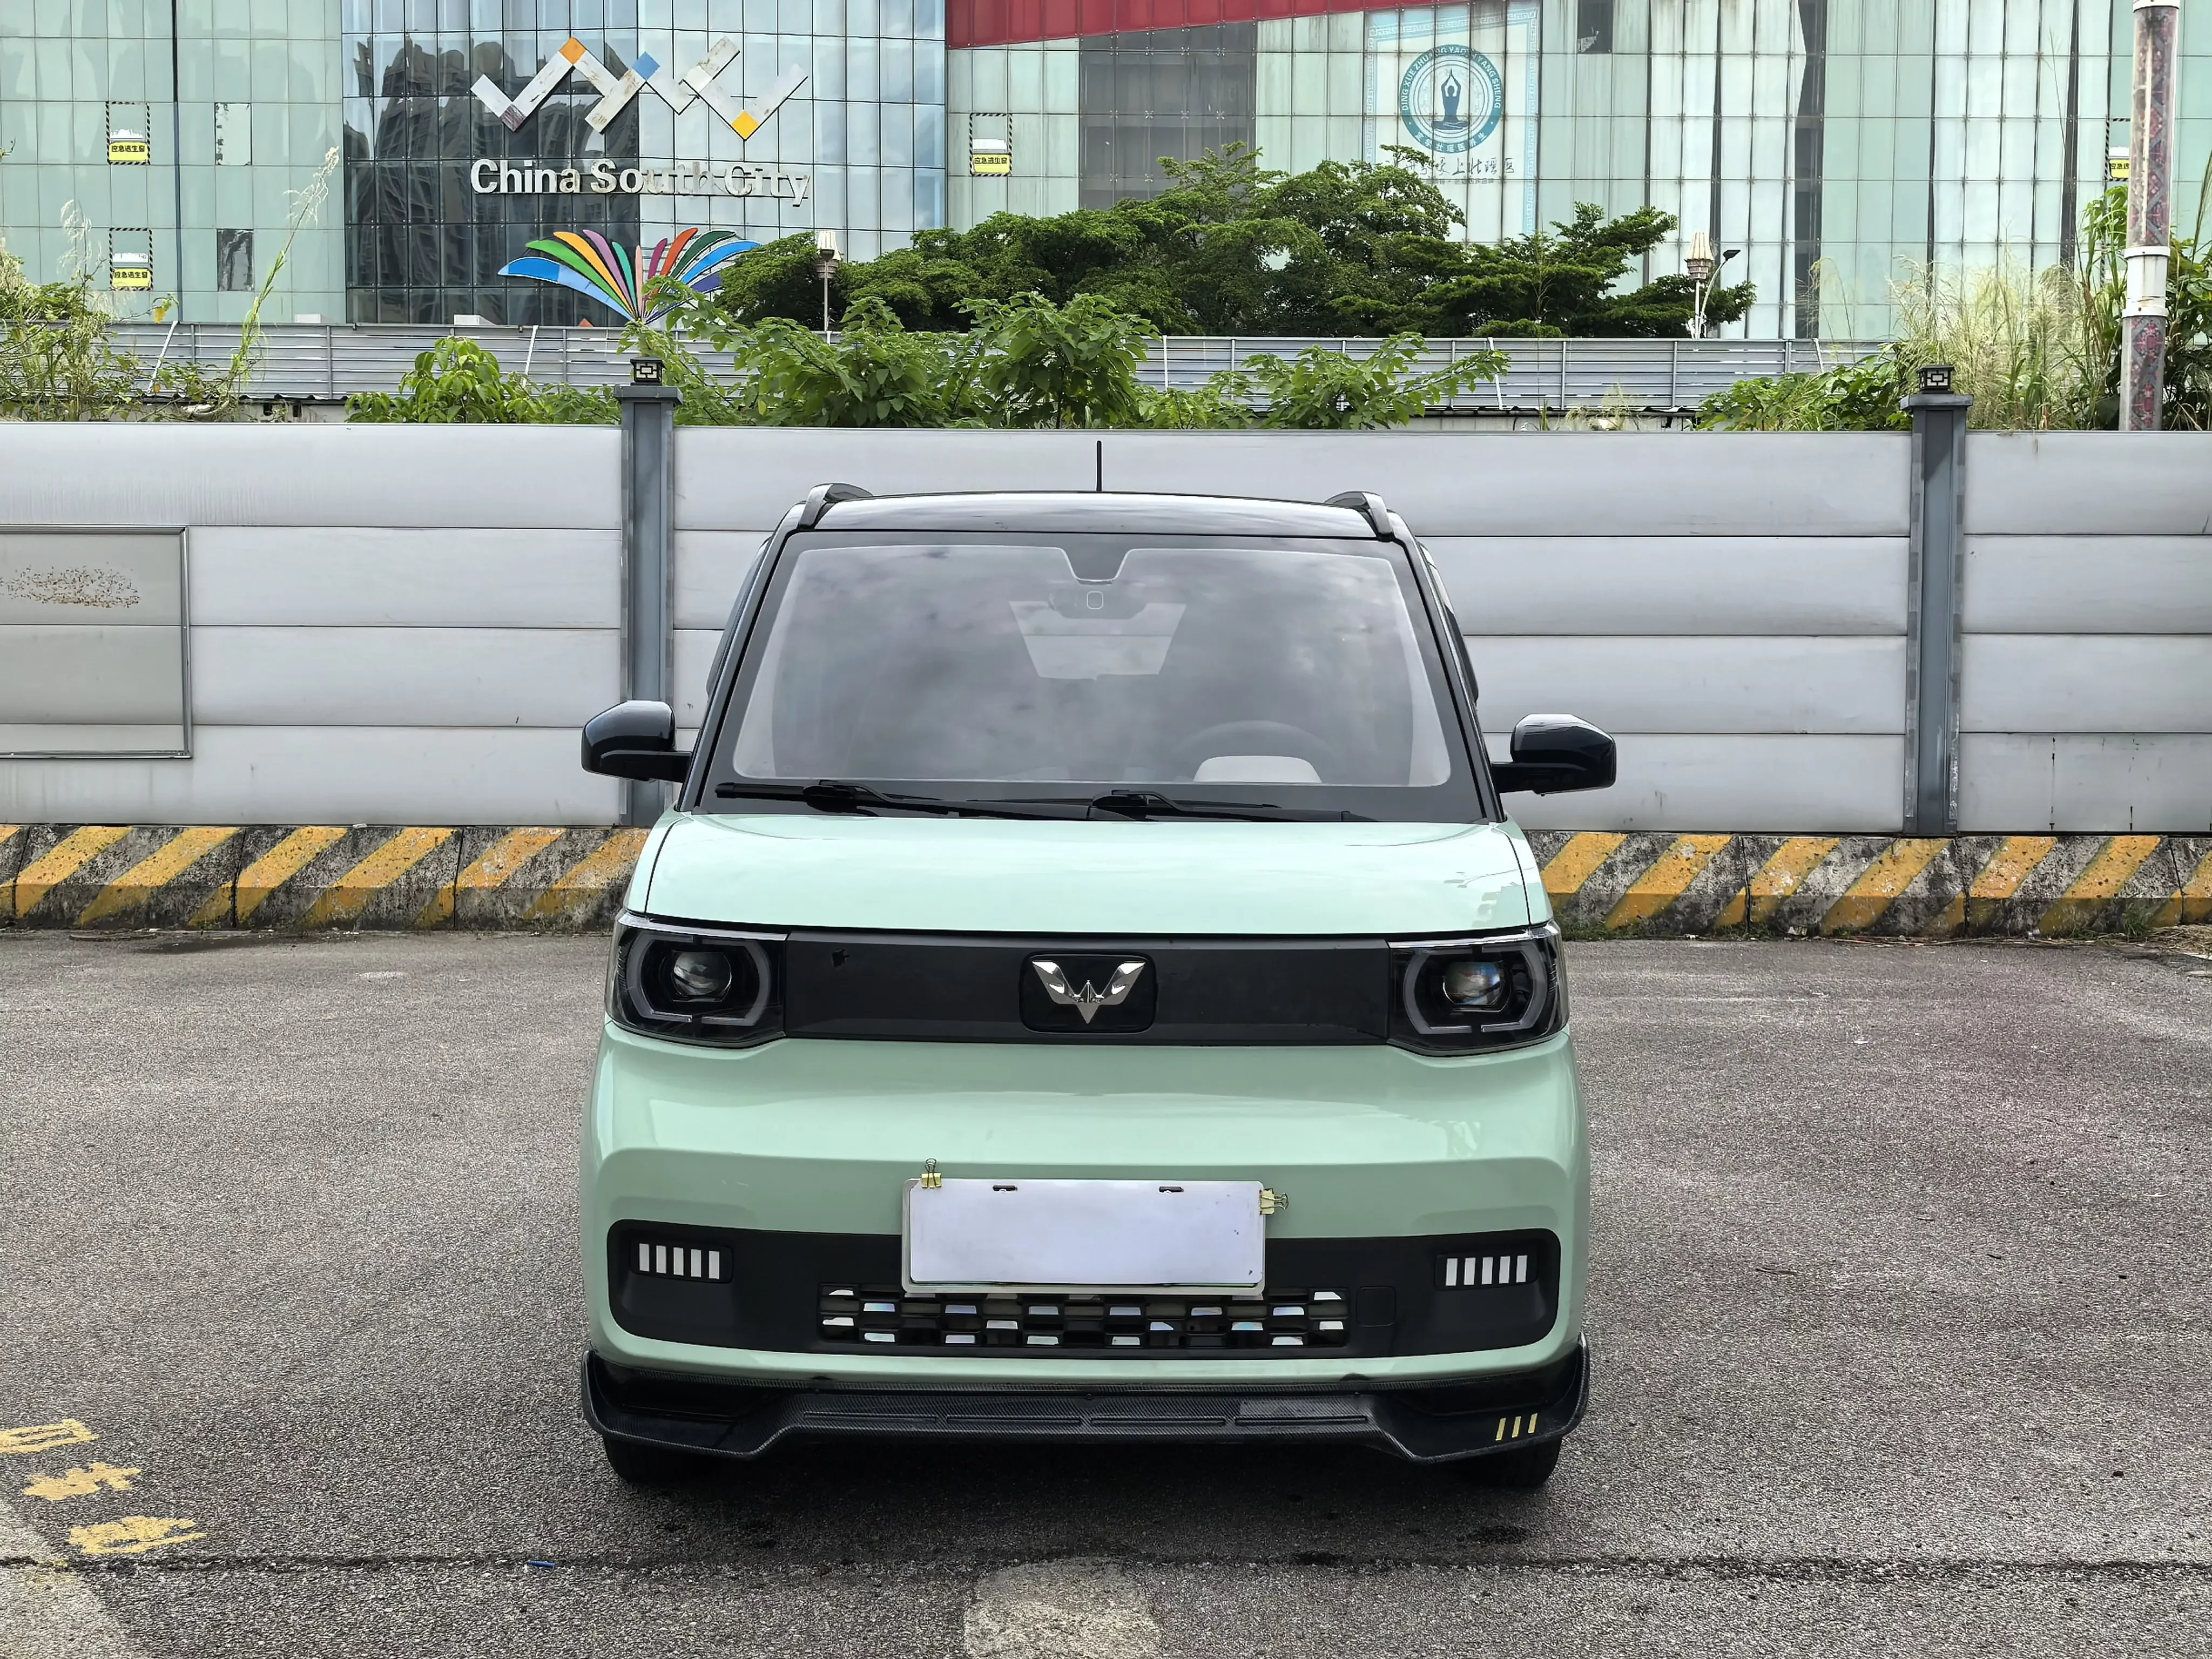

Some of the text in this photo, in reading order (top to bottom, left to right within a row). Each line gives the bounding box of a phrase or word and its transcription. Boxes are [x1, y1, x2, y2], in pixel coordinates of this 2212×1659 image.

[470, 158, 811, 207] China South City
